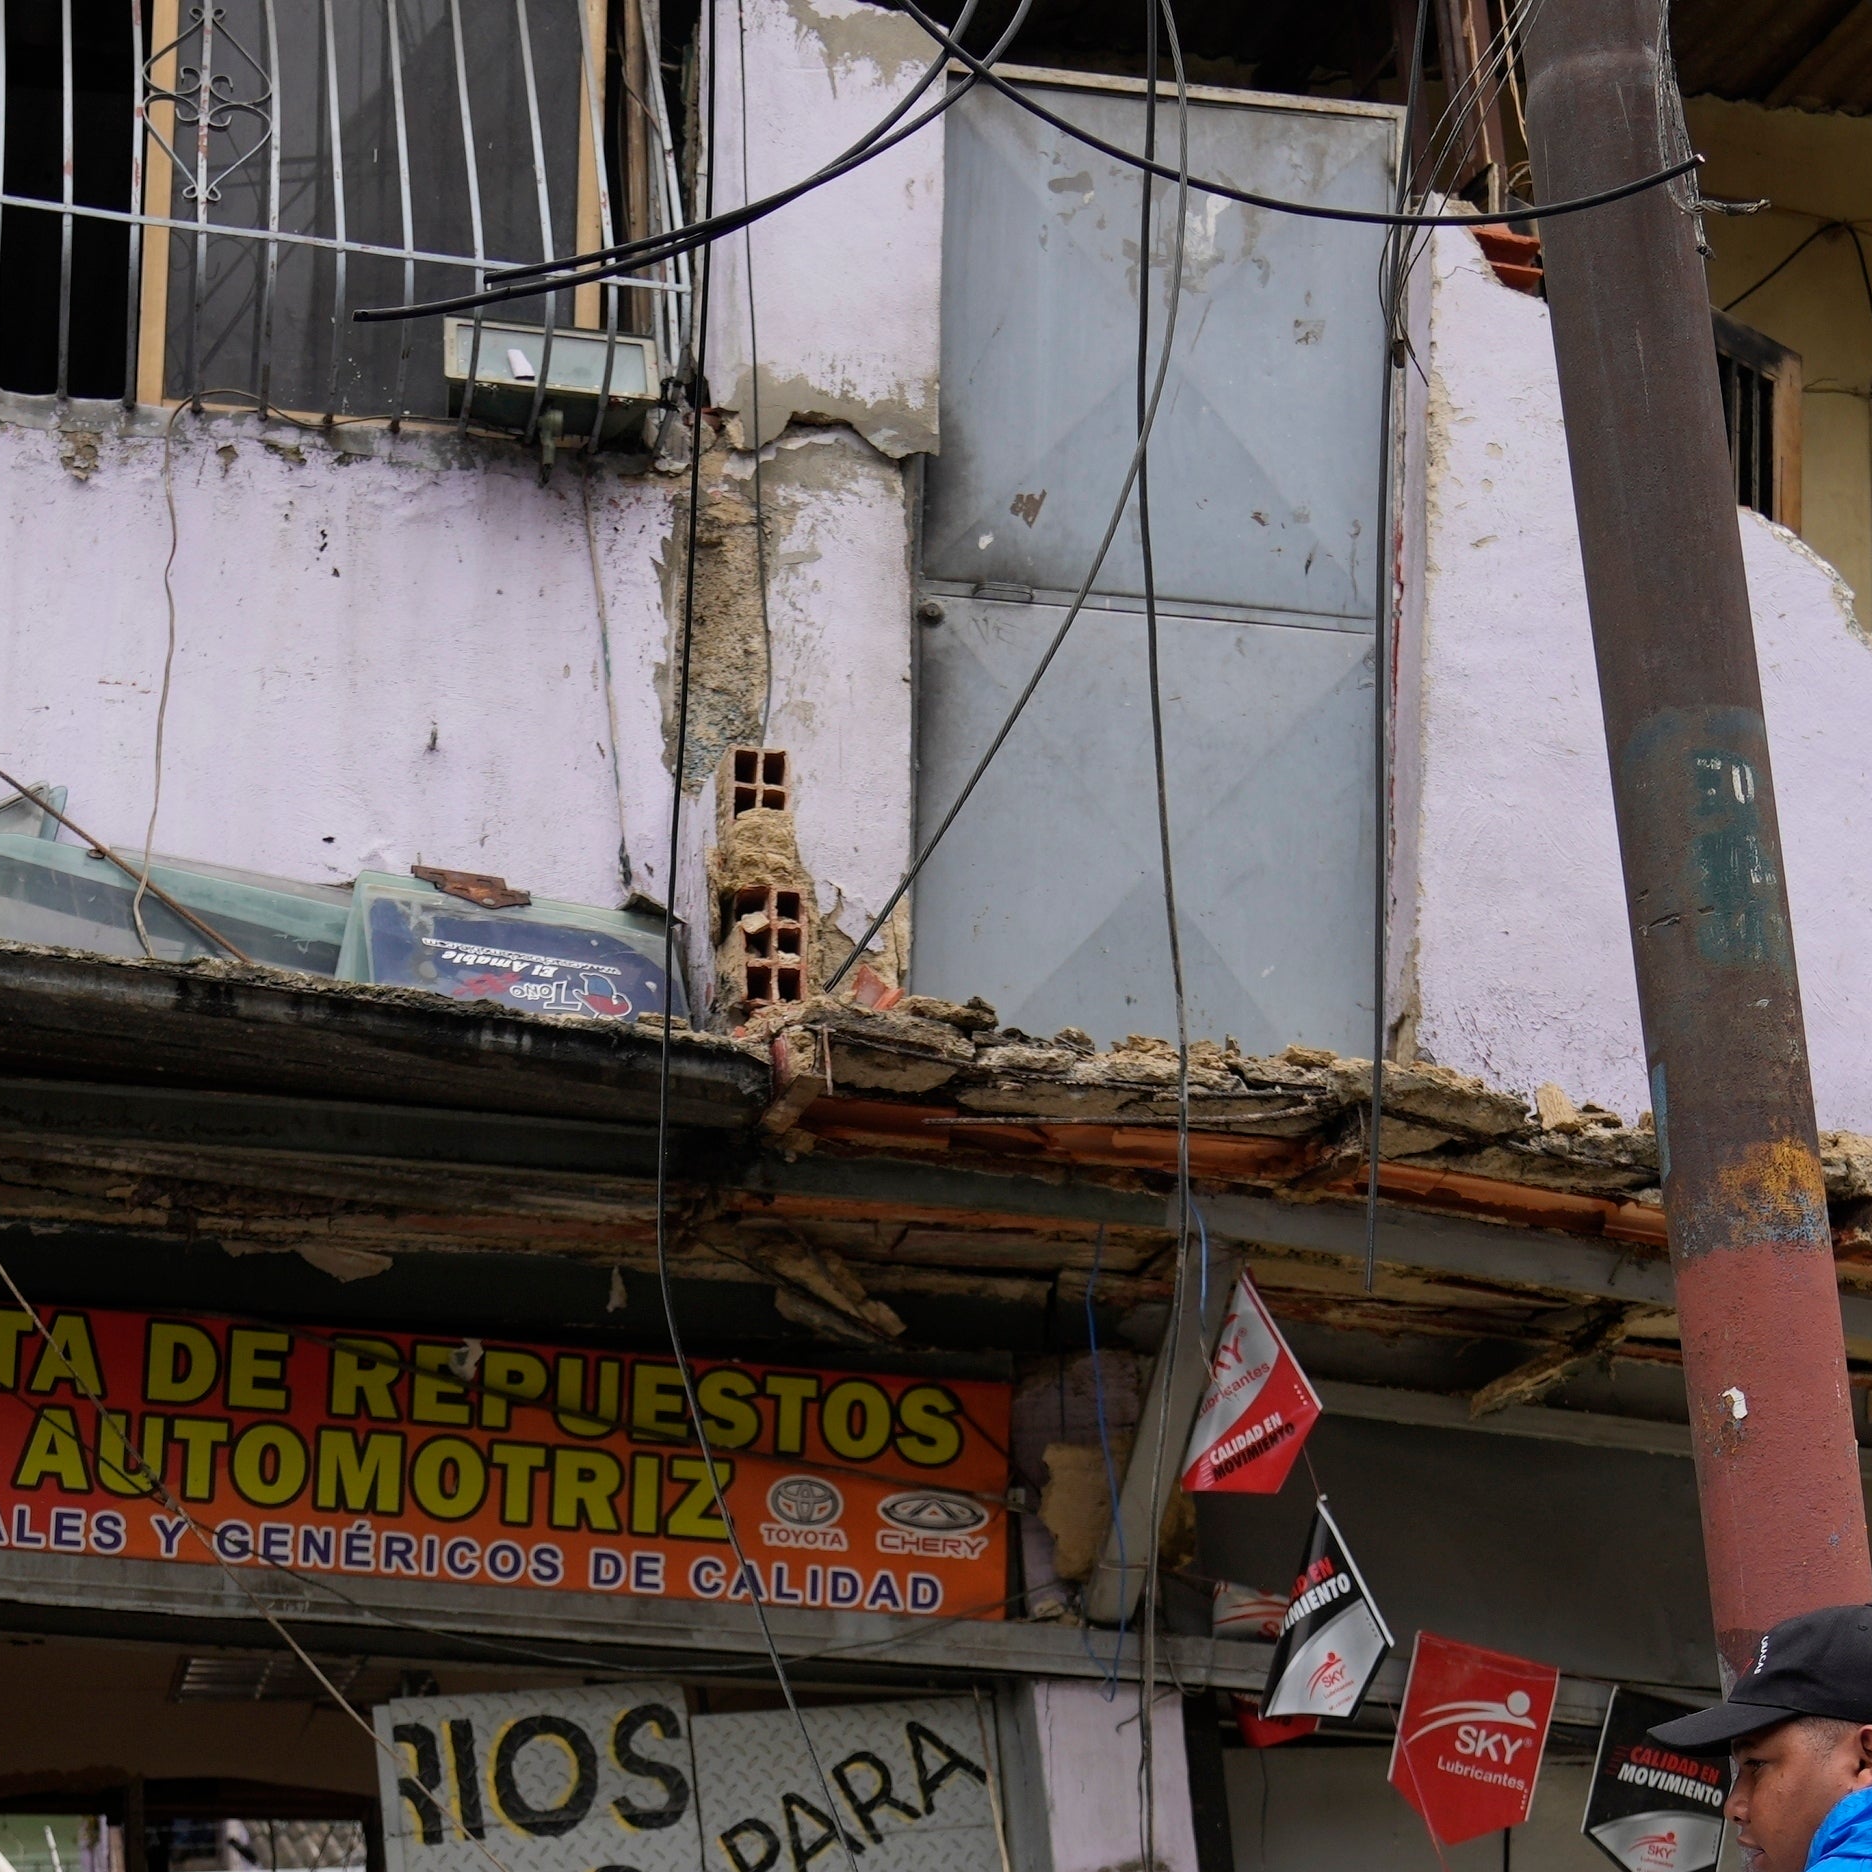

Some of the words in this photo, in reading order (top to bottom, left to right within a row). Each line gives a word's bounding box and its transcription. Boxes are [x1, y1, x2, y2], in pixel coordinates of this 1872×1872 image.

[145, 1322, 294, 1411] DE
[329, 1337, 966, 1467] REPUESTOS
[1209, 1424, 1264, 1467] CALIDAD
[1263, 1411, 1284, 1433] EN
[1212, 1422, 1296, 1482] MOVIMIENTO
[15, 1409, 734, 1543] AUTOMOTRIZ
[762, 1525, 847, 1550] TOYOTA
[878, 1531, 987, 1557] CHERY
[153, 1517, 189, 1556] Y
[214, 1520, 564, 1583] GENÉRICOS
[589, 1551, 665, 1592] DE
[690, 1559, 943, 1614] CALIDAD
[1321, 1666, 1345, 1689] SKY
[1454, 1725, 1524, 1765] SKY
[1630, 1744, 1700, 1778] CALIDAD
[1701, 1763, 1722, 1784] EN
[1437, 1755, 1526, 1791] Lubricantes
[1617, 1762, 1724, 1808] MOVIMIENTO
[1646, 1843, 1674, 1860] SKY
